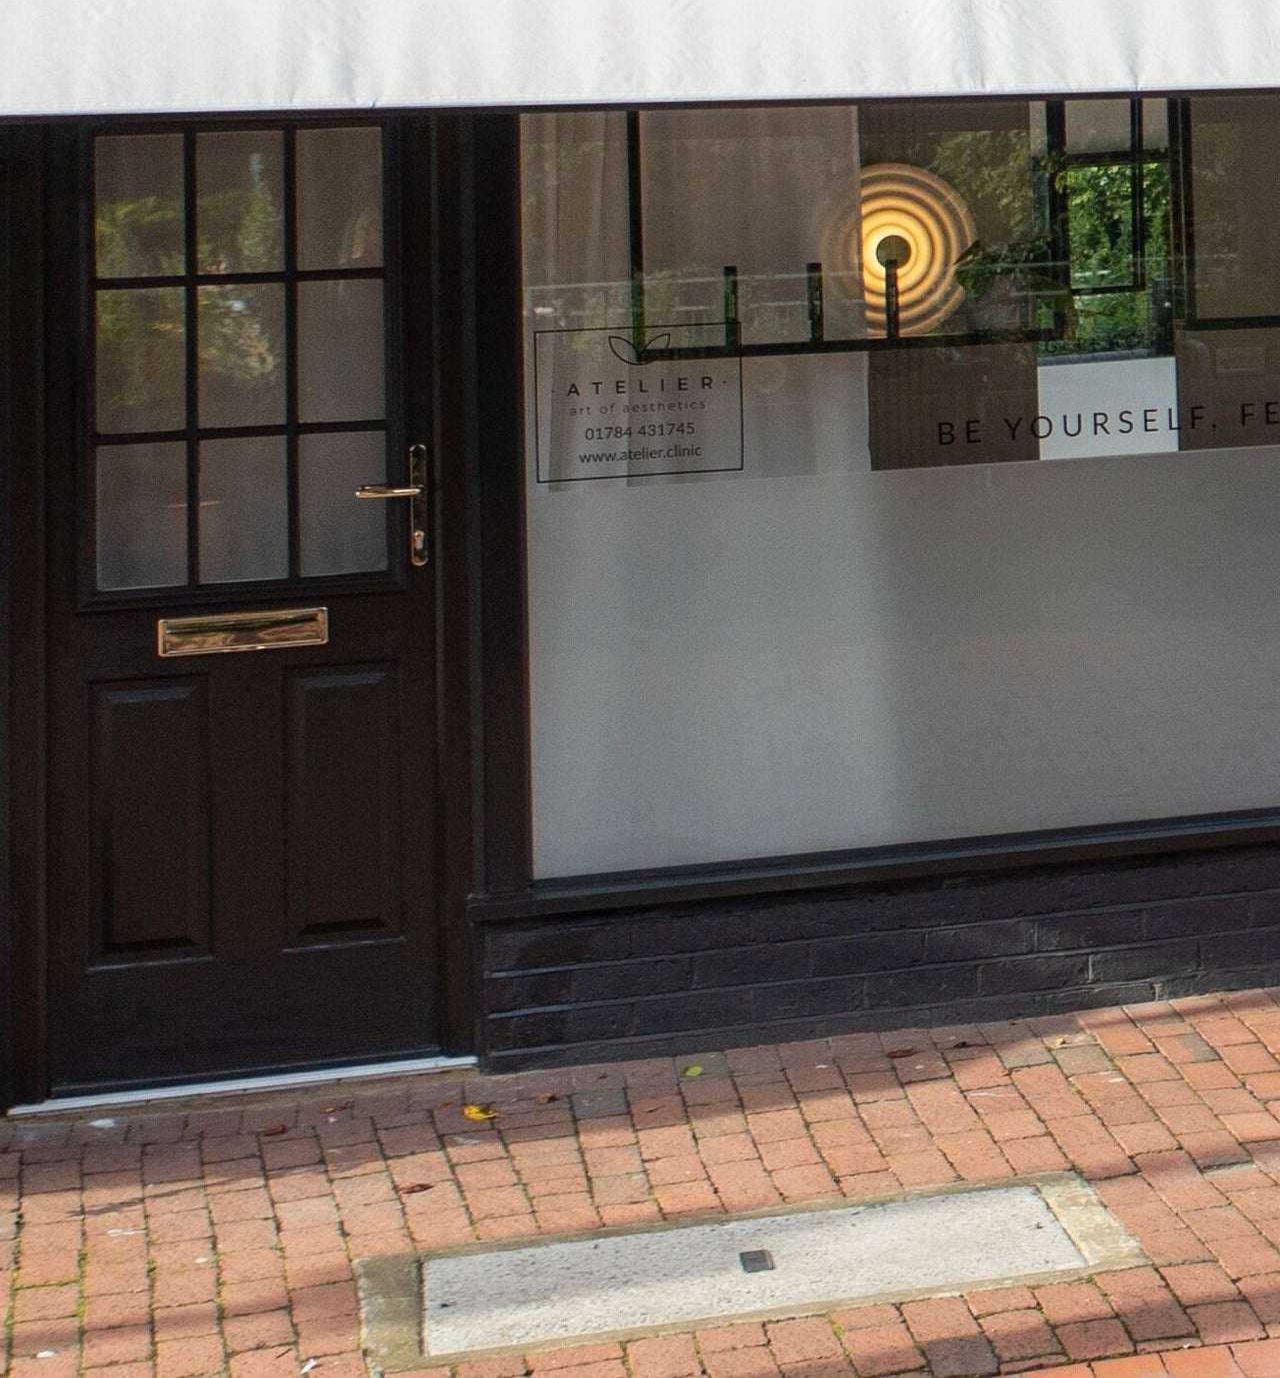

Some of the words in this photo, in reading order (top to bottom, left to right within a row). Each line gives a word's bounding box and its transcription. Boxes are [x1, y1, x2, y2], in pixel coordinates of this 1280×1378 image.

[566, 376, 714, 397] ATELIER
[569, 404, 591, 417] art
[600, 402, 615, 414] of
[622, 399, 706, 414] aesthetics
[585, 425, 632, 441] 01784
[638, 422, 695, 437] 431745
[937, 420, 982, 446] BE
[1003, 405, 1217, 441] YOURSELF,
[578, 444, 702, 464] www.atelier.clinic
